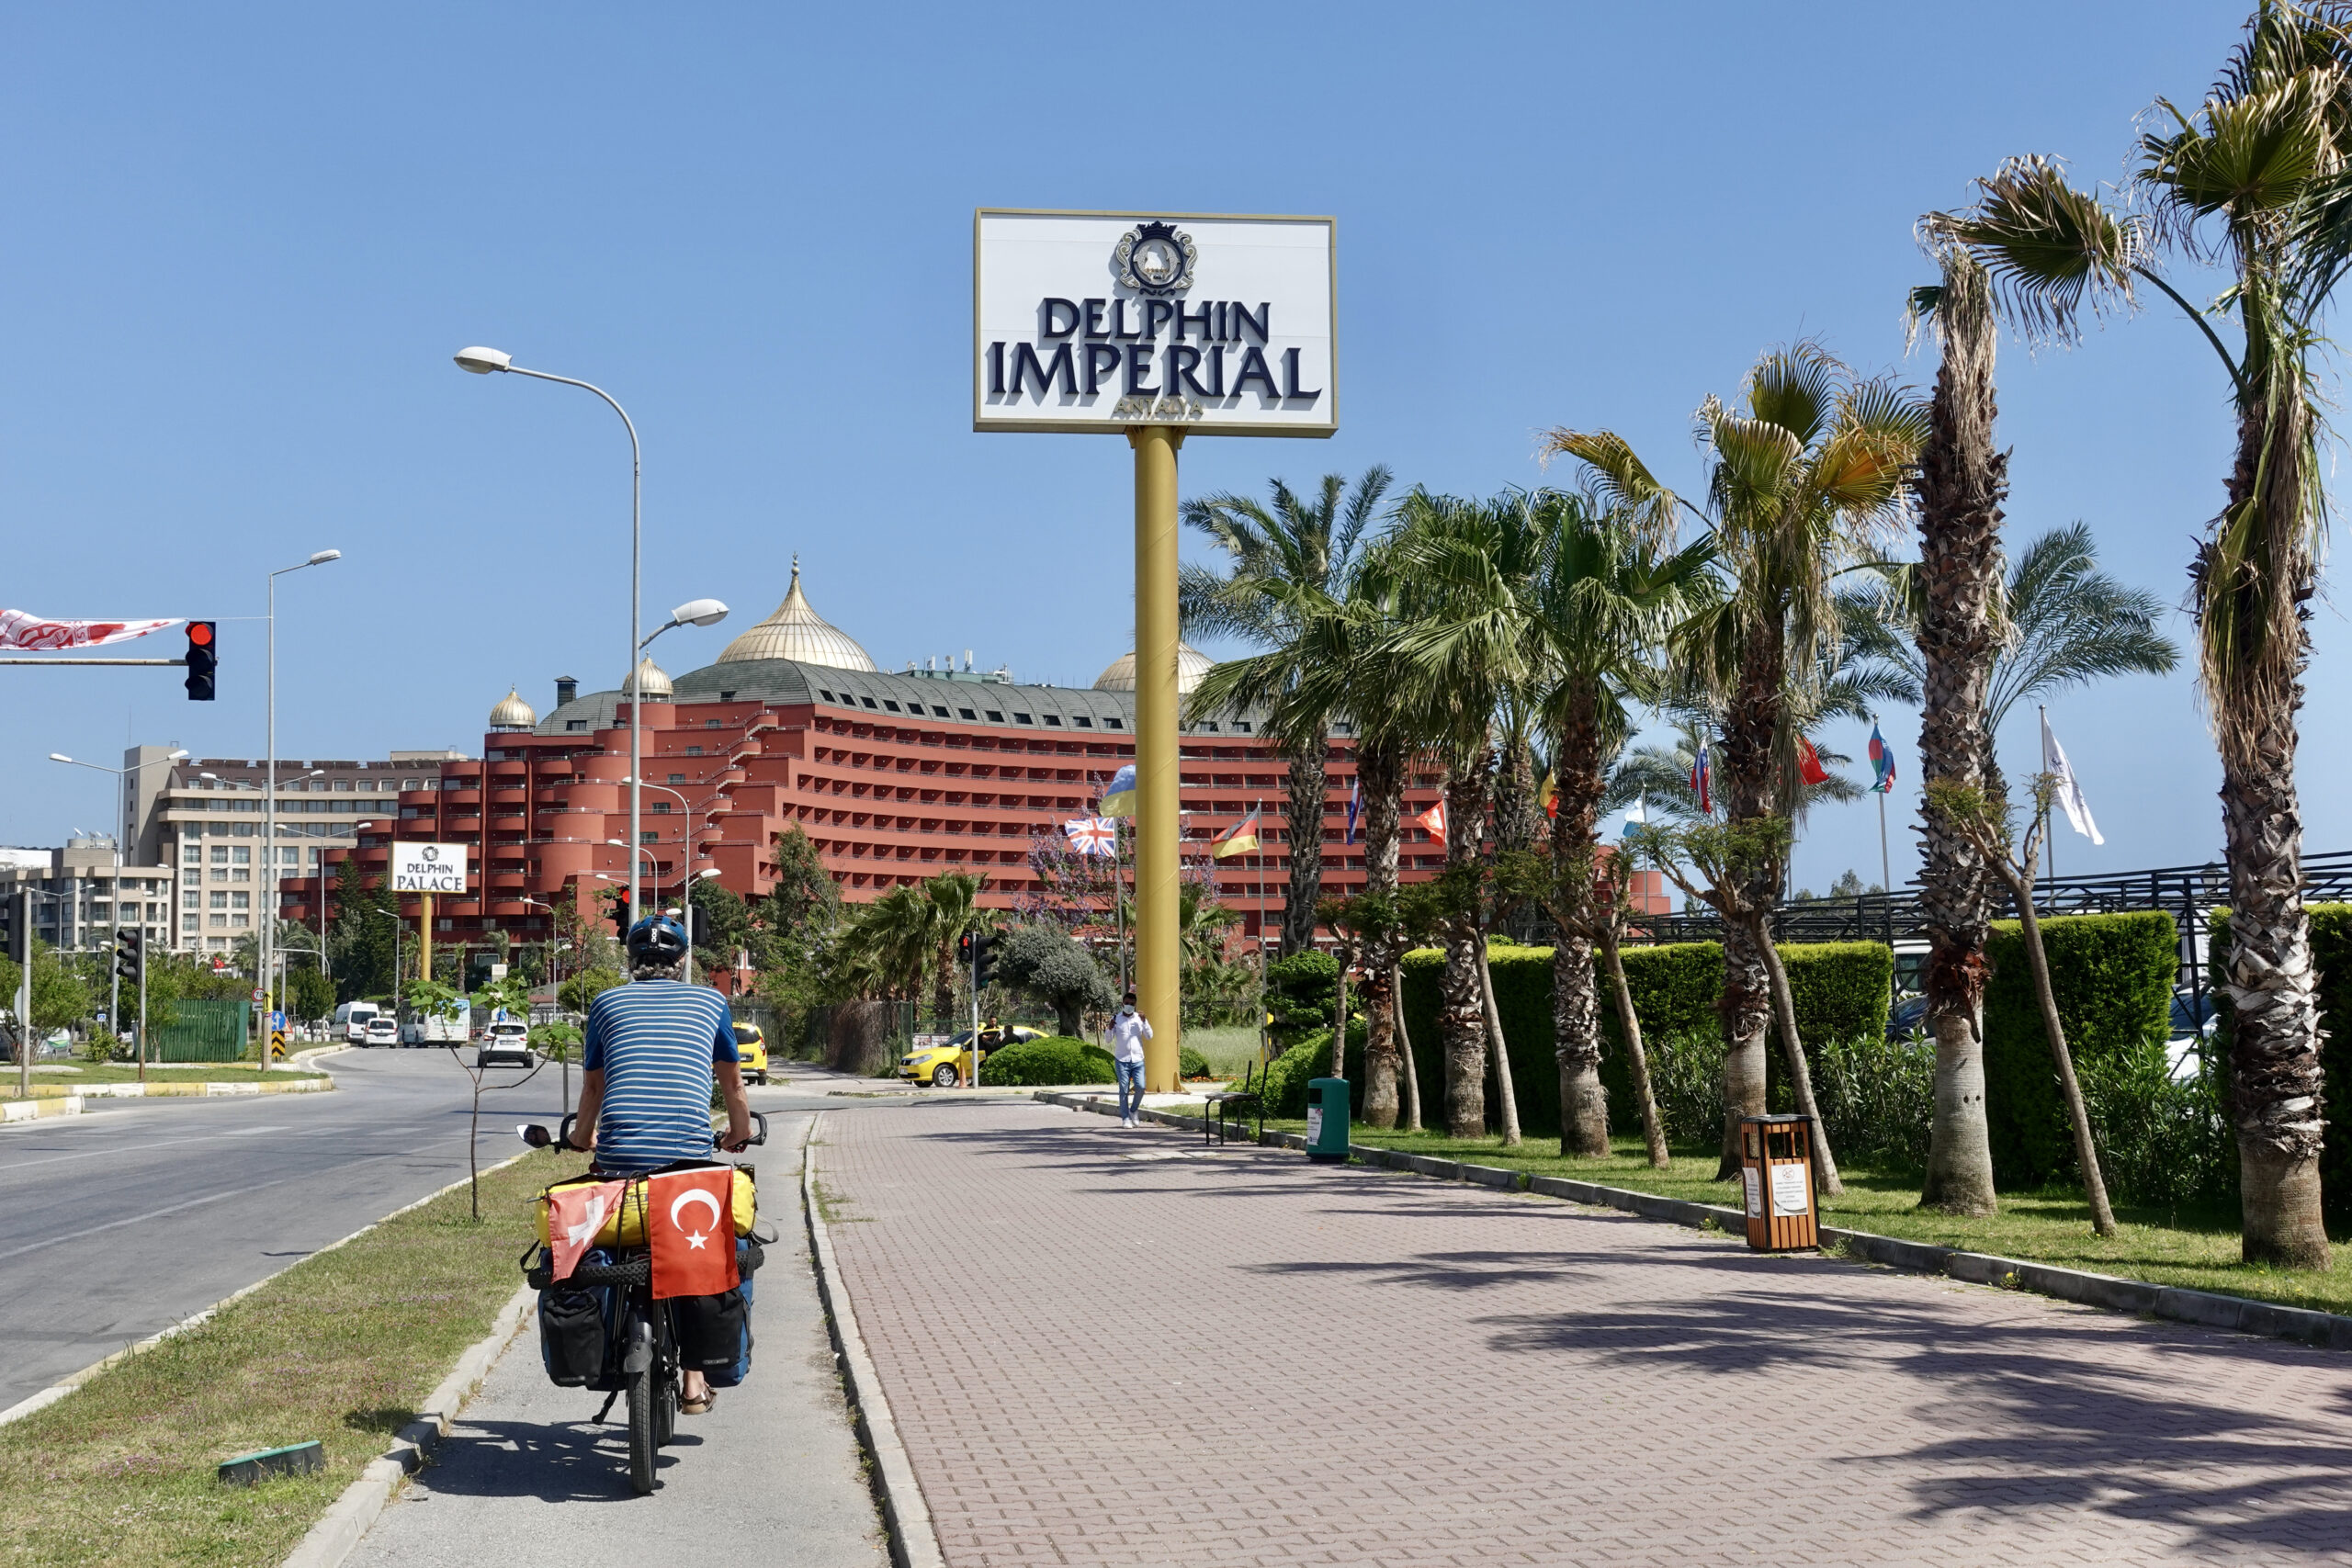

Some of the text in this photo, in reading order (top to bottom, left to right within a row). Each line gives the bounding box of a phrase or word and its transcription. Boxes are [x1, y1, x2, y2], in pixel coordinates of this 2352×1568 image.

[1043, 297, 1272, 344] DELPHIN
[991, 341, 1323, 399] IMPERIAL
[1113, 397, 1204, 415] ANTALYA
[407, 863, 453, 874] DELPHIN
[397, 875, 462, 891] PALACE
